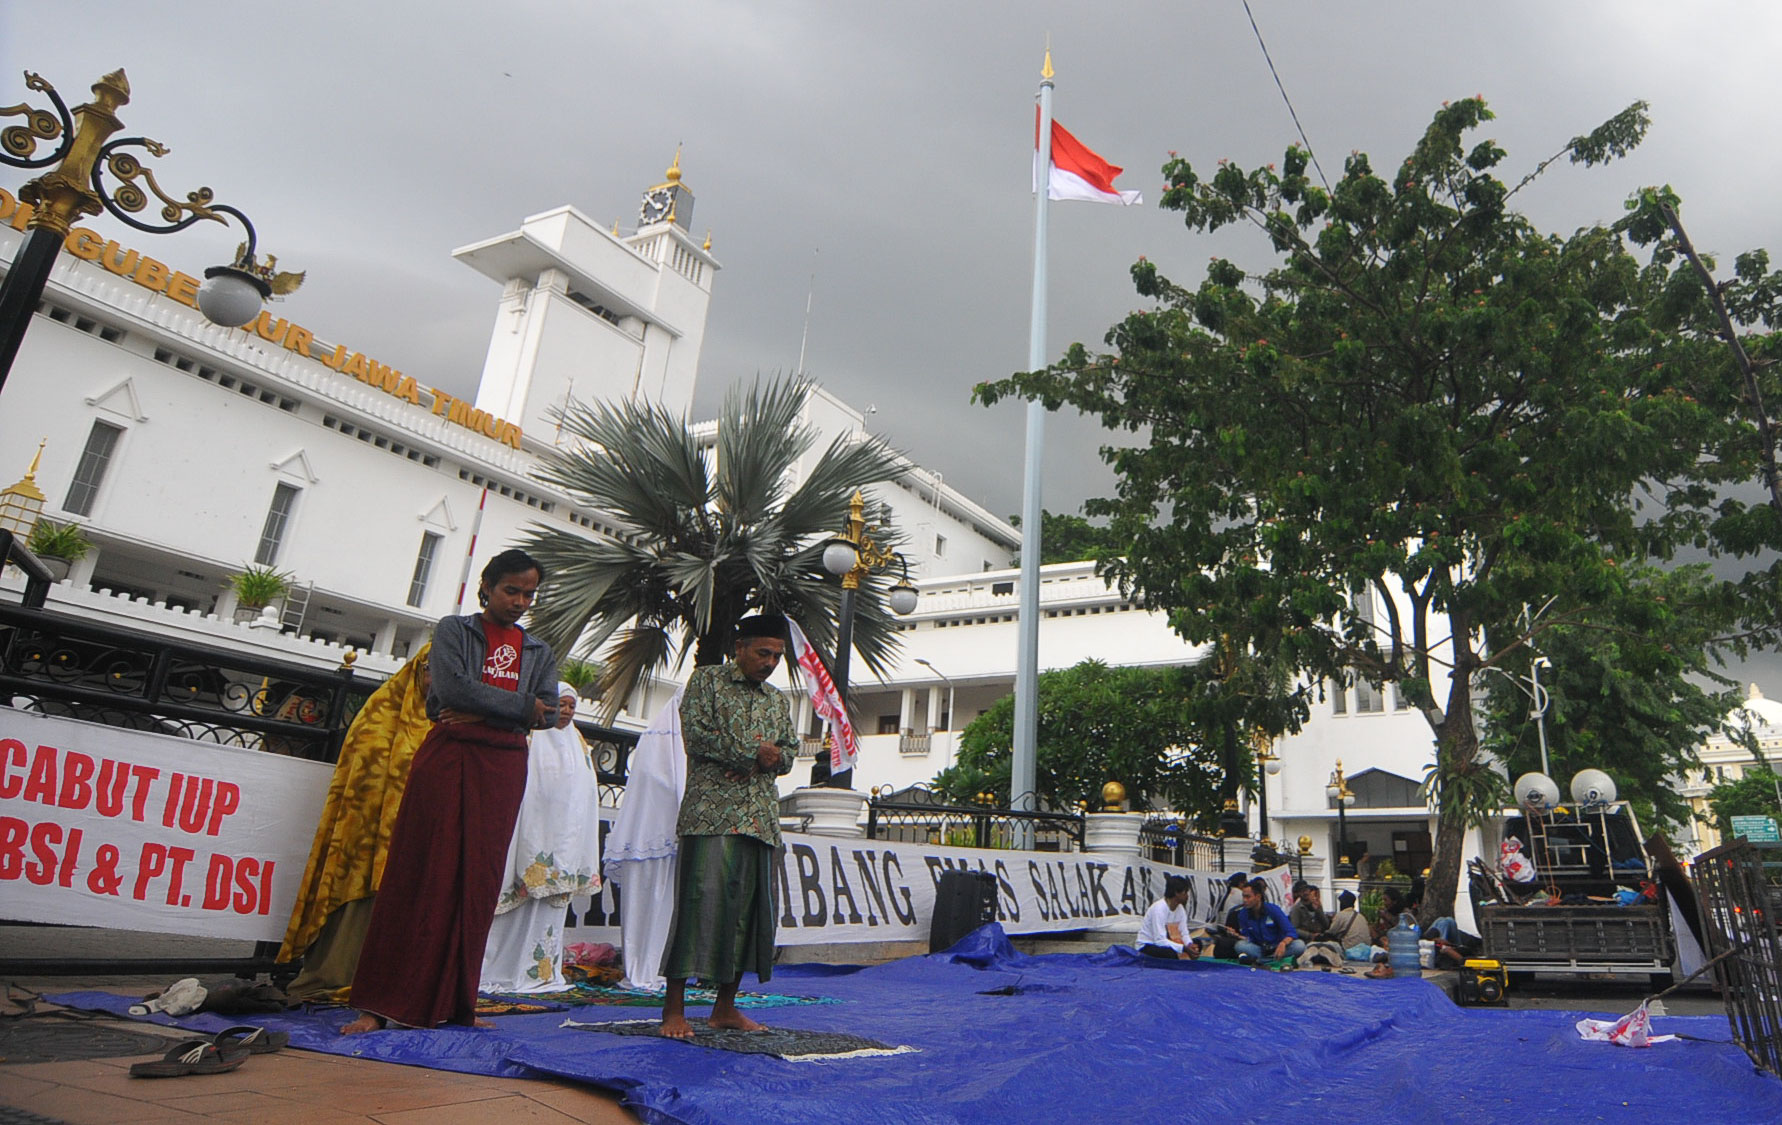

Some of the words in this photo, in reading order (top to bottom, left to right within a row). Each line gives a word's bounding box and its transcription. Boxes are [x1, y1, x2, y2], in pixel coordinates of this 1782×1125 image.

[64, 226, 314, 359] GUBEUR
[320, 344, 420, 406] JAWA
[430, 387, 523, 450] TIMUR
[0, 738, 160, 822] CABUT
[162, 772, 240, 836] IUP
[0, 816, 83, 888] BSI
[87, 843, 123, 896] &
[133, 842, 194, 908] PT.
[201, 853, 276, 916] DSI
